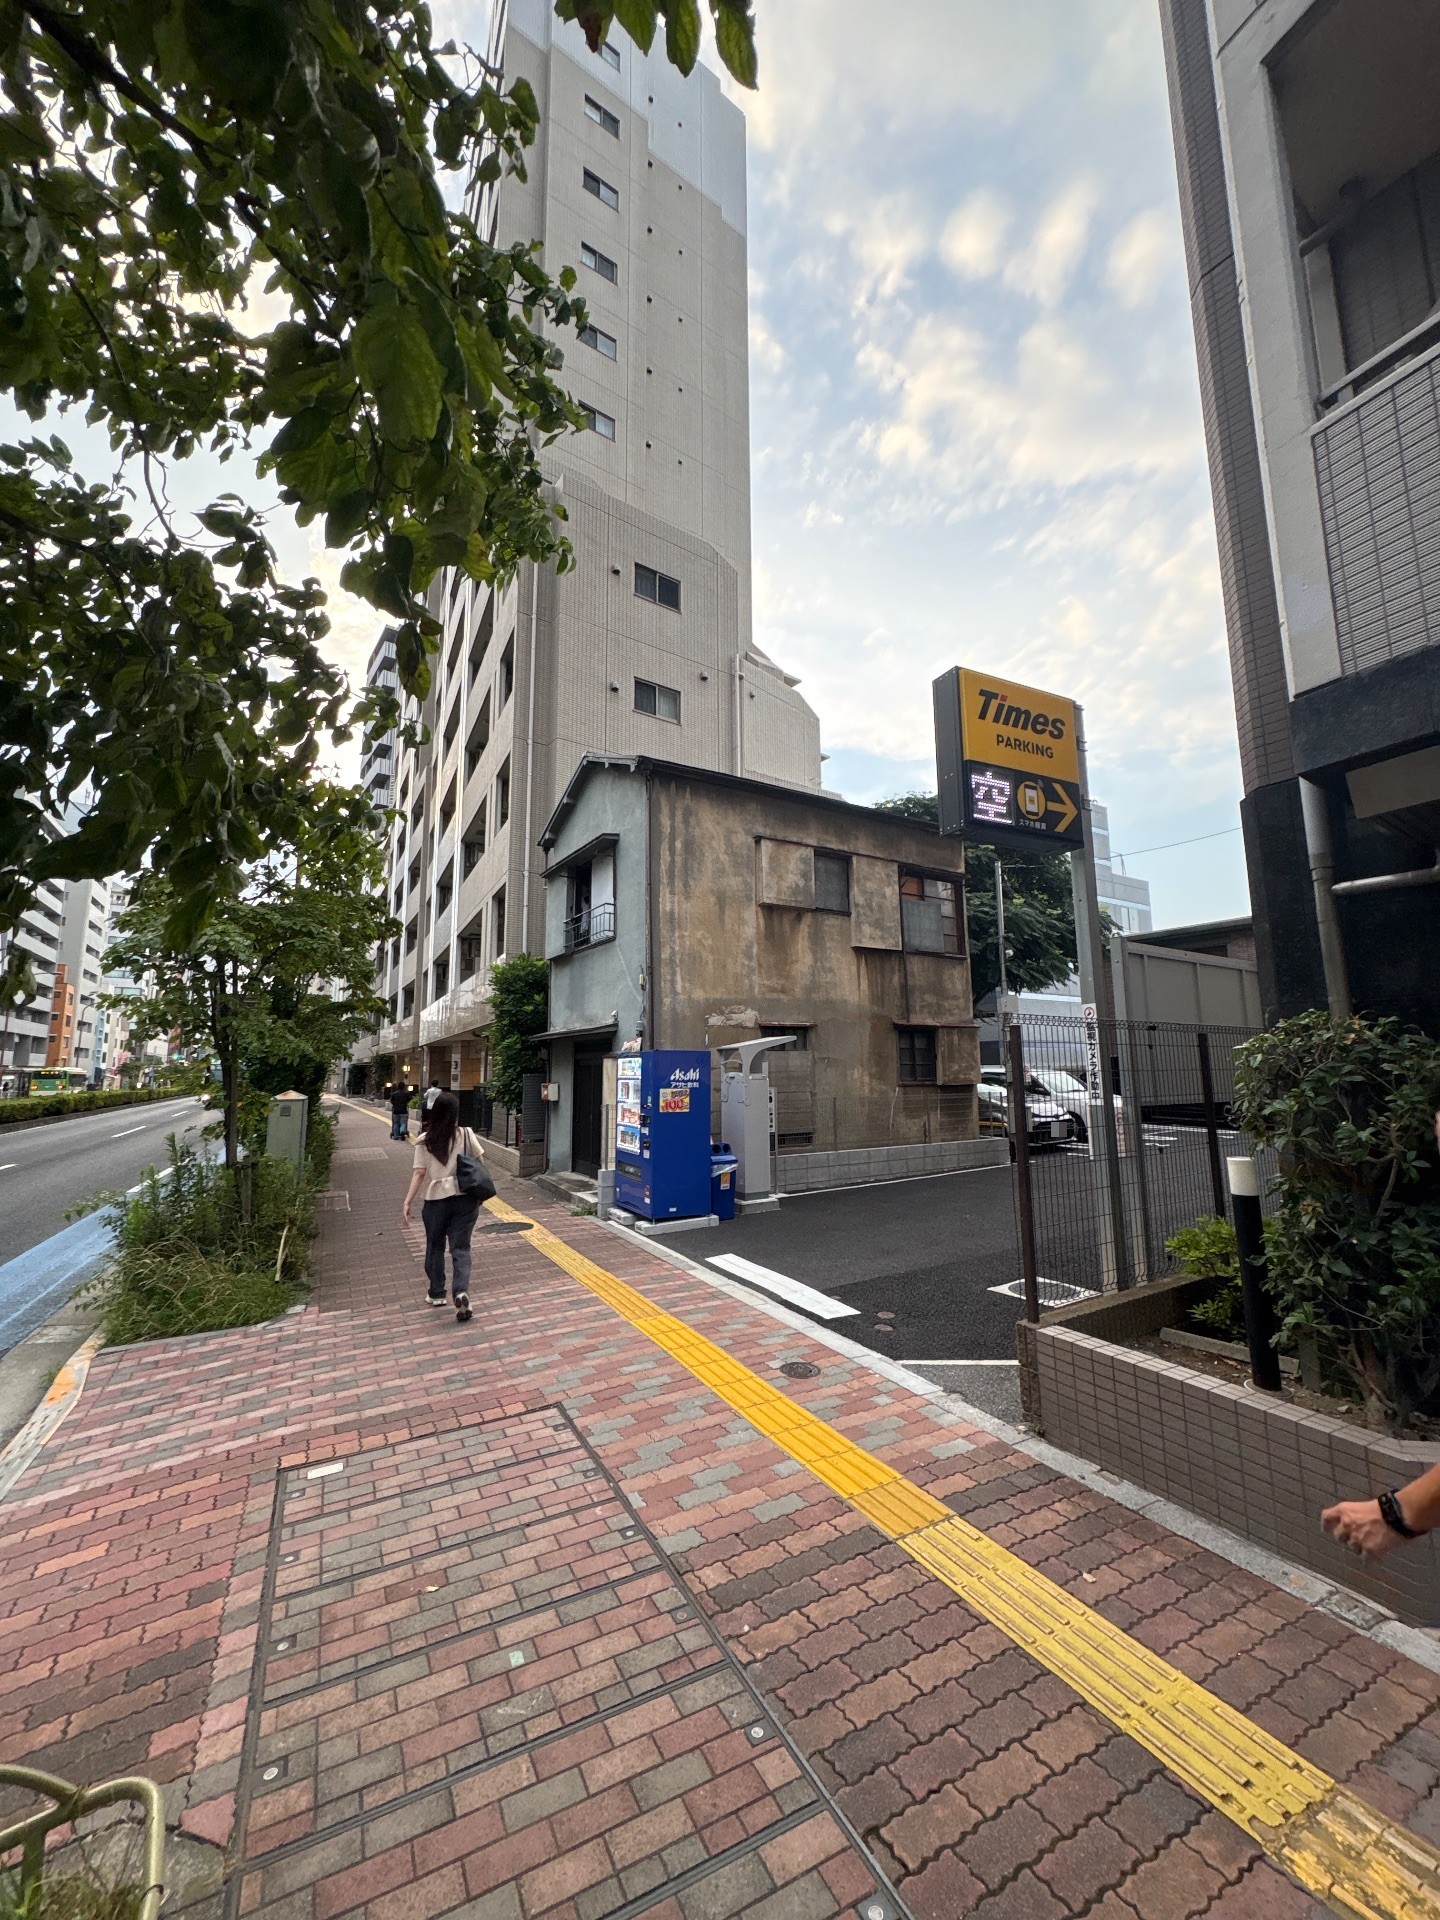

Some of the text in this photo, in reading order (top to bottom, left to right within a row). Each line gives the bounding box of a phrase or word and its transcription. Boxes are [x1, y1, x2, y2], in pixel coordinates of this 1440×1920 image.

[977, 688, 1066, 740] Times
[996, 734, 1054, 759] PARKING
[971, 771, 1013, 824] 空
[670, 1067, 700, 1081] Asahi
[670, 1081, 700, 1089] アサヒ飲料
